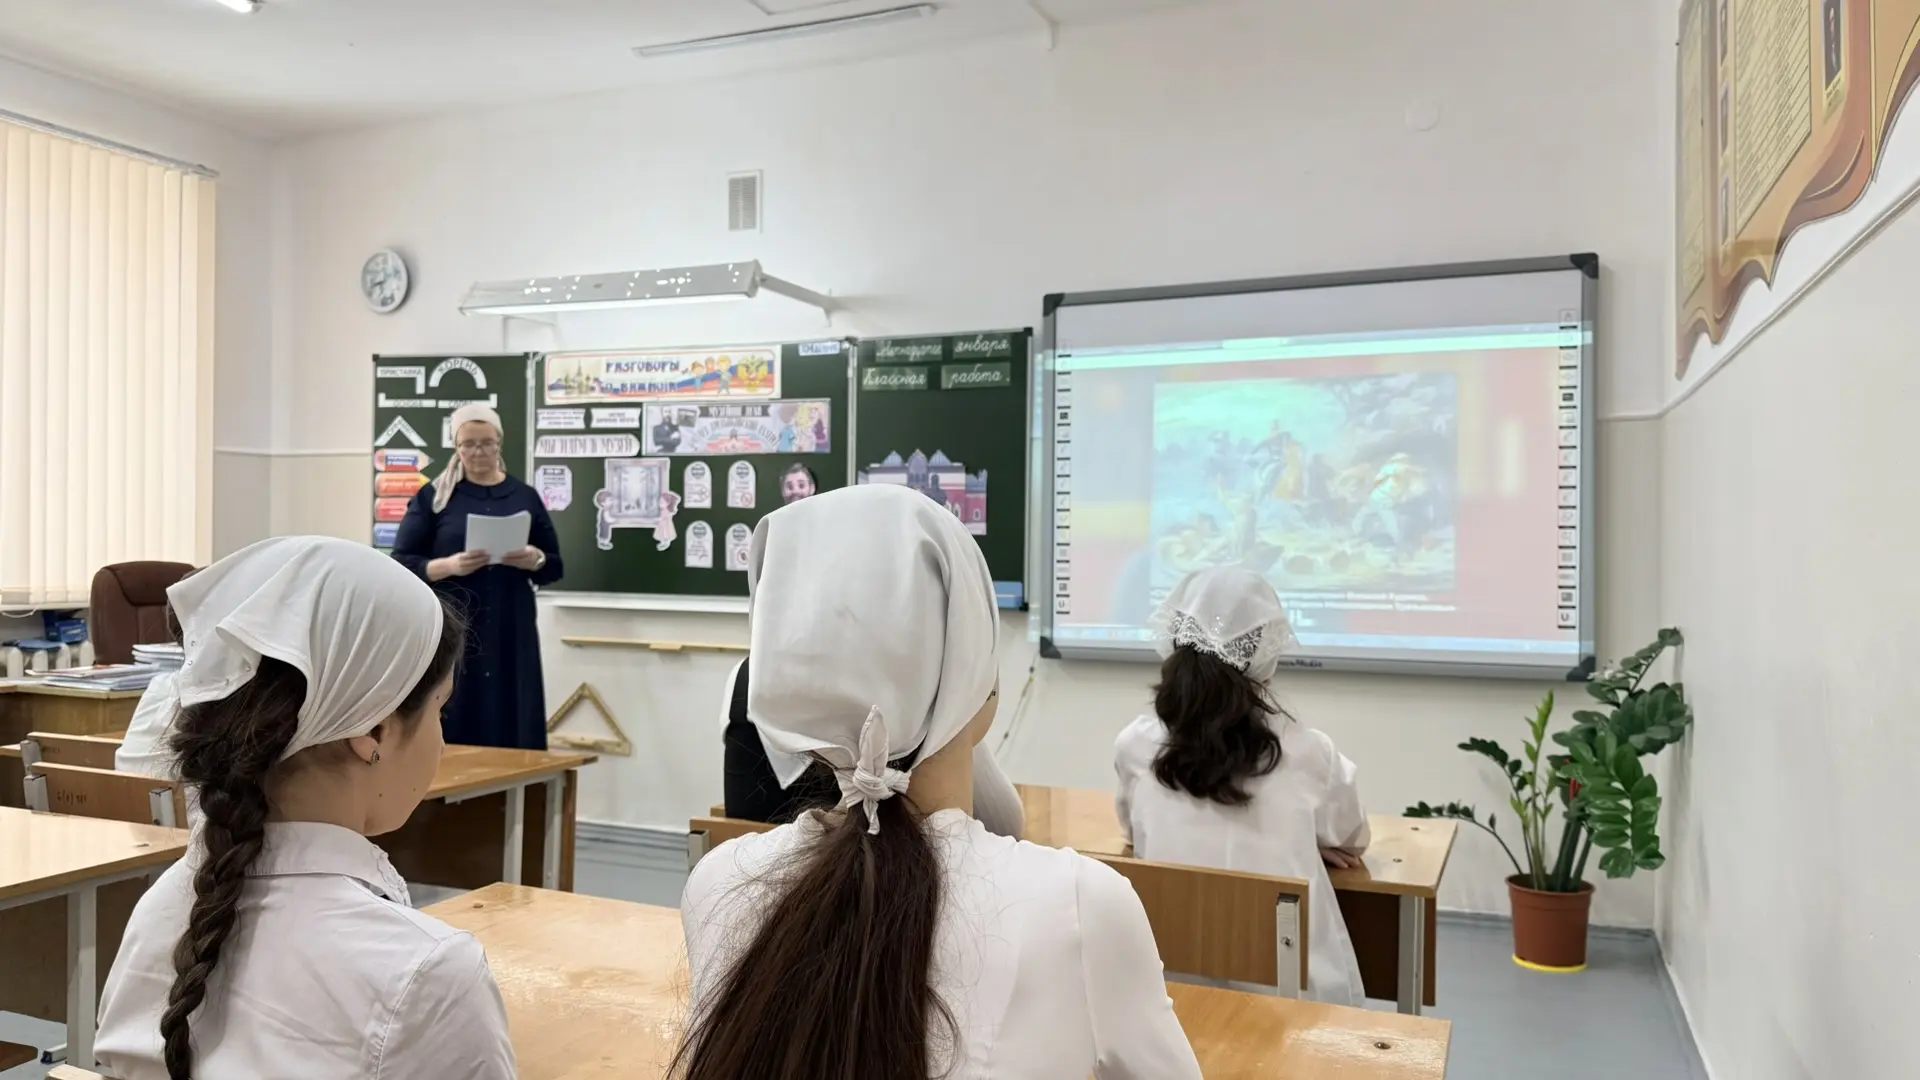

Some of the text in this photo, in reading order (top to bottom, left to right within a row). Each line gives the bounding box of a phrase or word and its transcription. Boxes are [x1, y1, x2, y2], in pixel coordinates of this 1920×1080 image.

[954, 334, 1009, 357] января
[606, 361, 680, 373] РАЗГОВОРЫ
[863, 369, 927, 386] Классная
